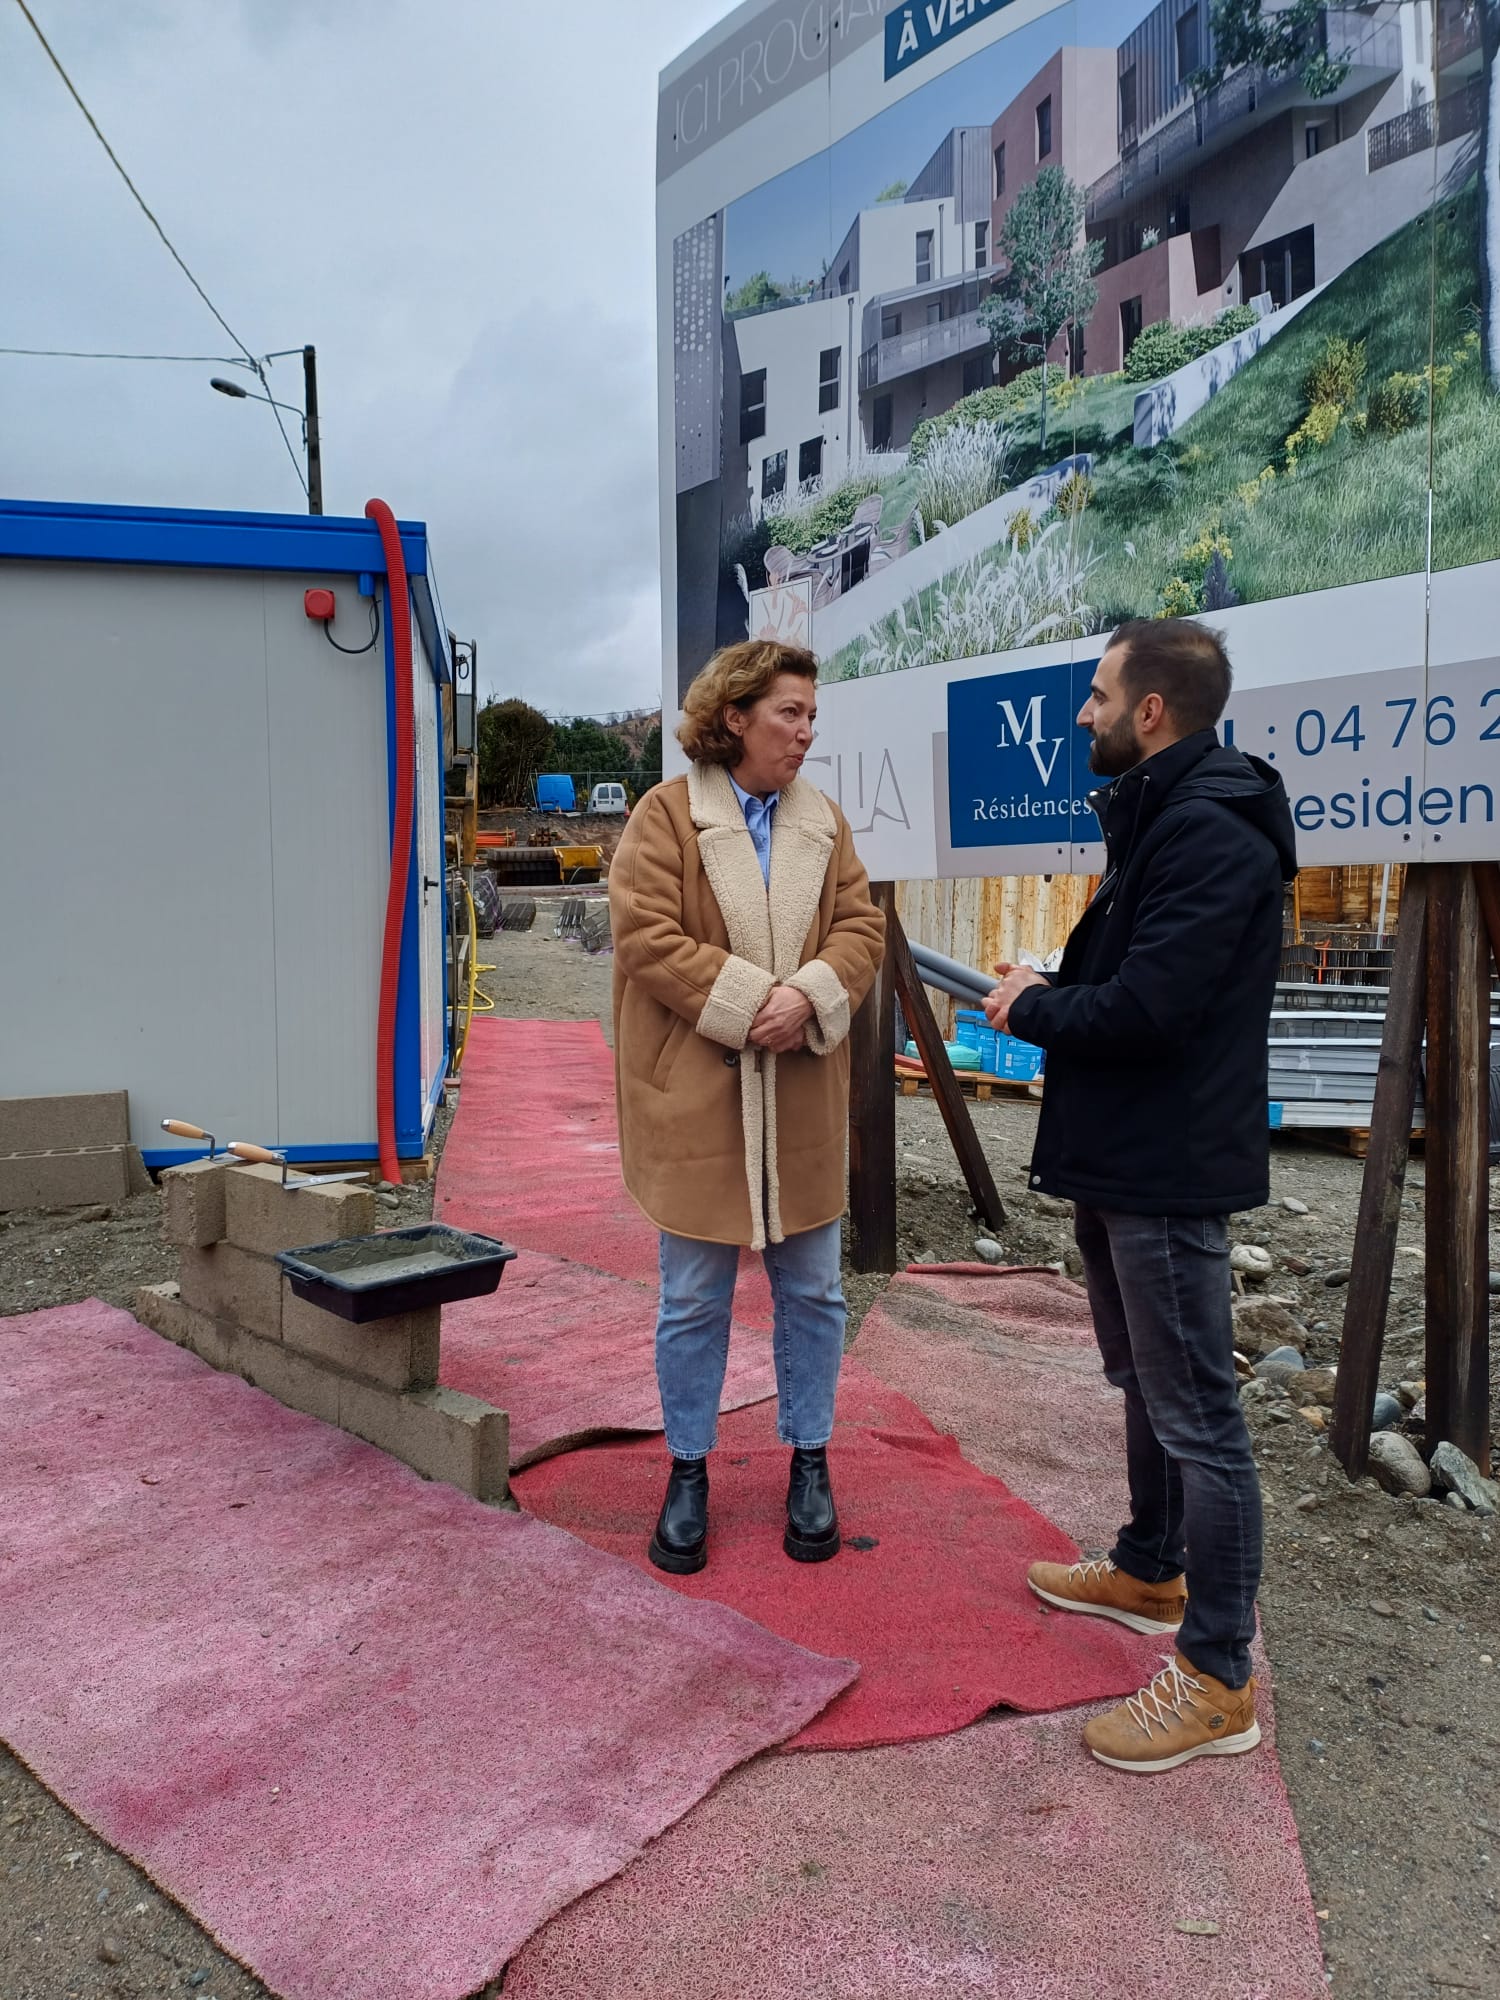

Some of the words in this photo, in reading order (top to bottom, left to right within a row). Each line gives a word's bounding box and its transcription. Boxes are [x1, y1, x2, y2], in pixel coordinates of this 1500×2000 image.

[674, 78, 709, 153] ICI
[716, 0, 882, 122] PROCHA
[1295, 704, 1366, 756] 04
[1385, 695, 1456, 747] 76
[973, 794, 1093, 821] Résidences
